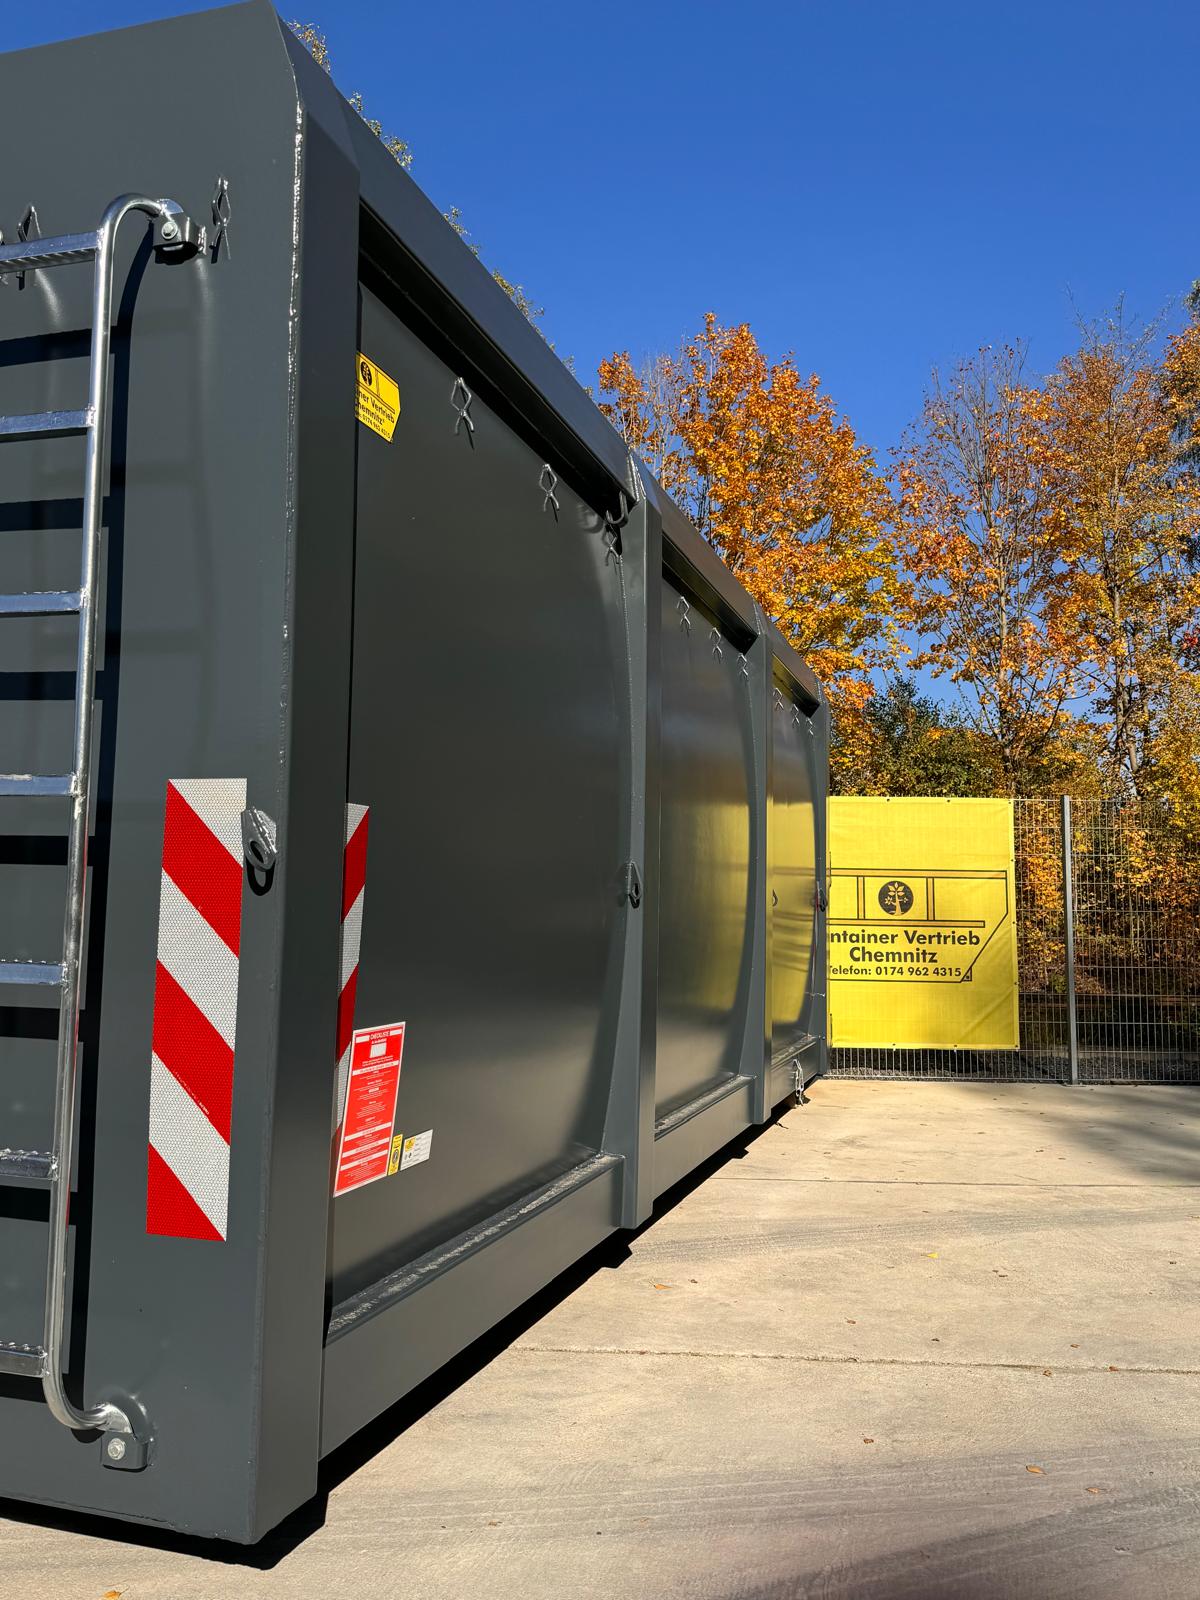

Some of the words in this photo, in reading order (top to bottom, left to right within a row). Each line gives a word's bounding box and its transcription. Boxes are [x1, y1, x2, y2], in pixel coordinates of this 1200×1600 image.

[369, 396, 394, 424] Vertrieb
[830, 929, 898, 944] ntainer
[904, 930, 980, 945] Vertrieb
[849, 946, 938, 963] Chemnitz
[876, 966, 904, 976] 0174
[908, 967, 929, 976] 962
[933, 967, 961, 977] 4315
